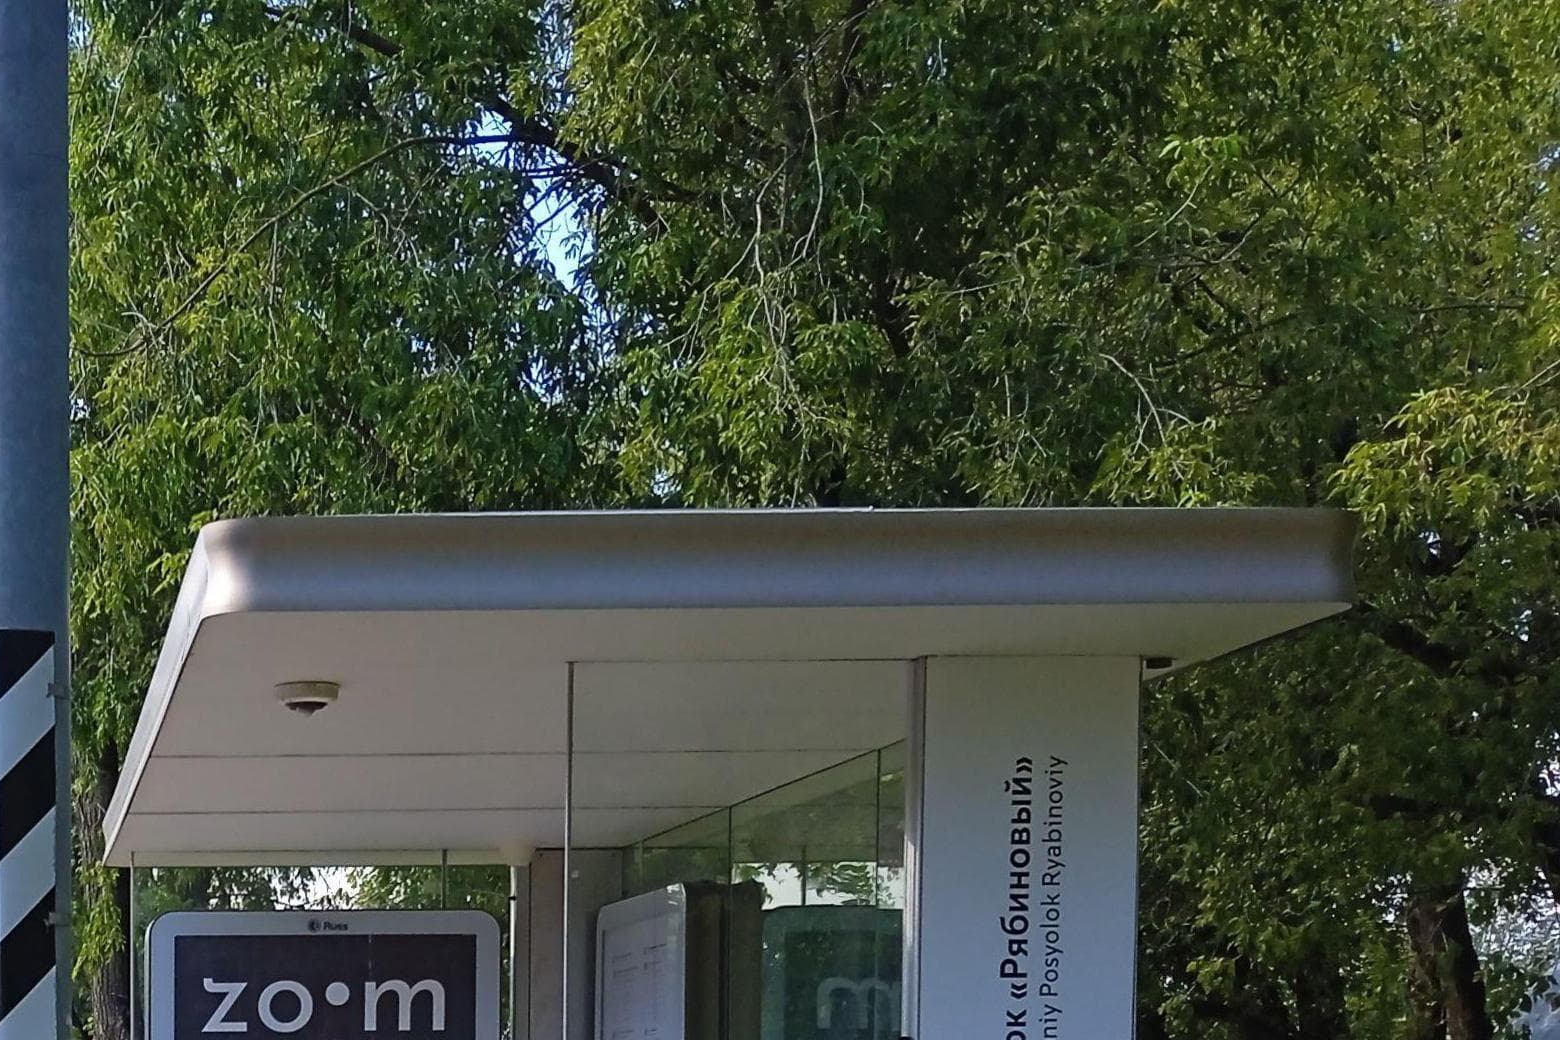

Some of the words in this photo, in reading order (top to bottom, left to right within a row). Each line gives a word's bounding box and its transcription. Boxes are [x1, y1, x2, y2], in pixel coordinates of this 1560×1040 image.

[1000, 756, 1032, 999] «Рябиновый»
[1042, 755, 1068, 886] Ryabinoviy
[1039, 893, 1065, 997] Posyolok
